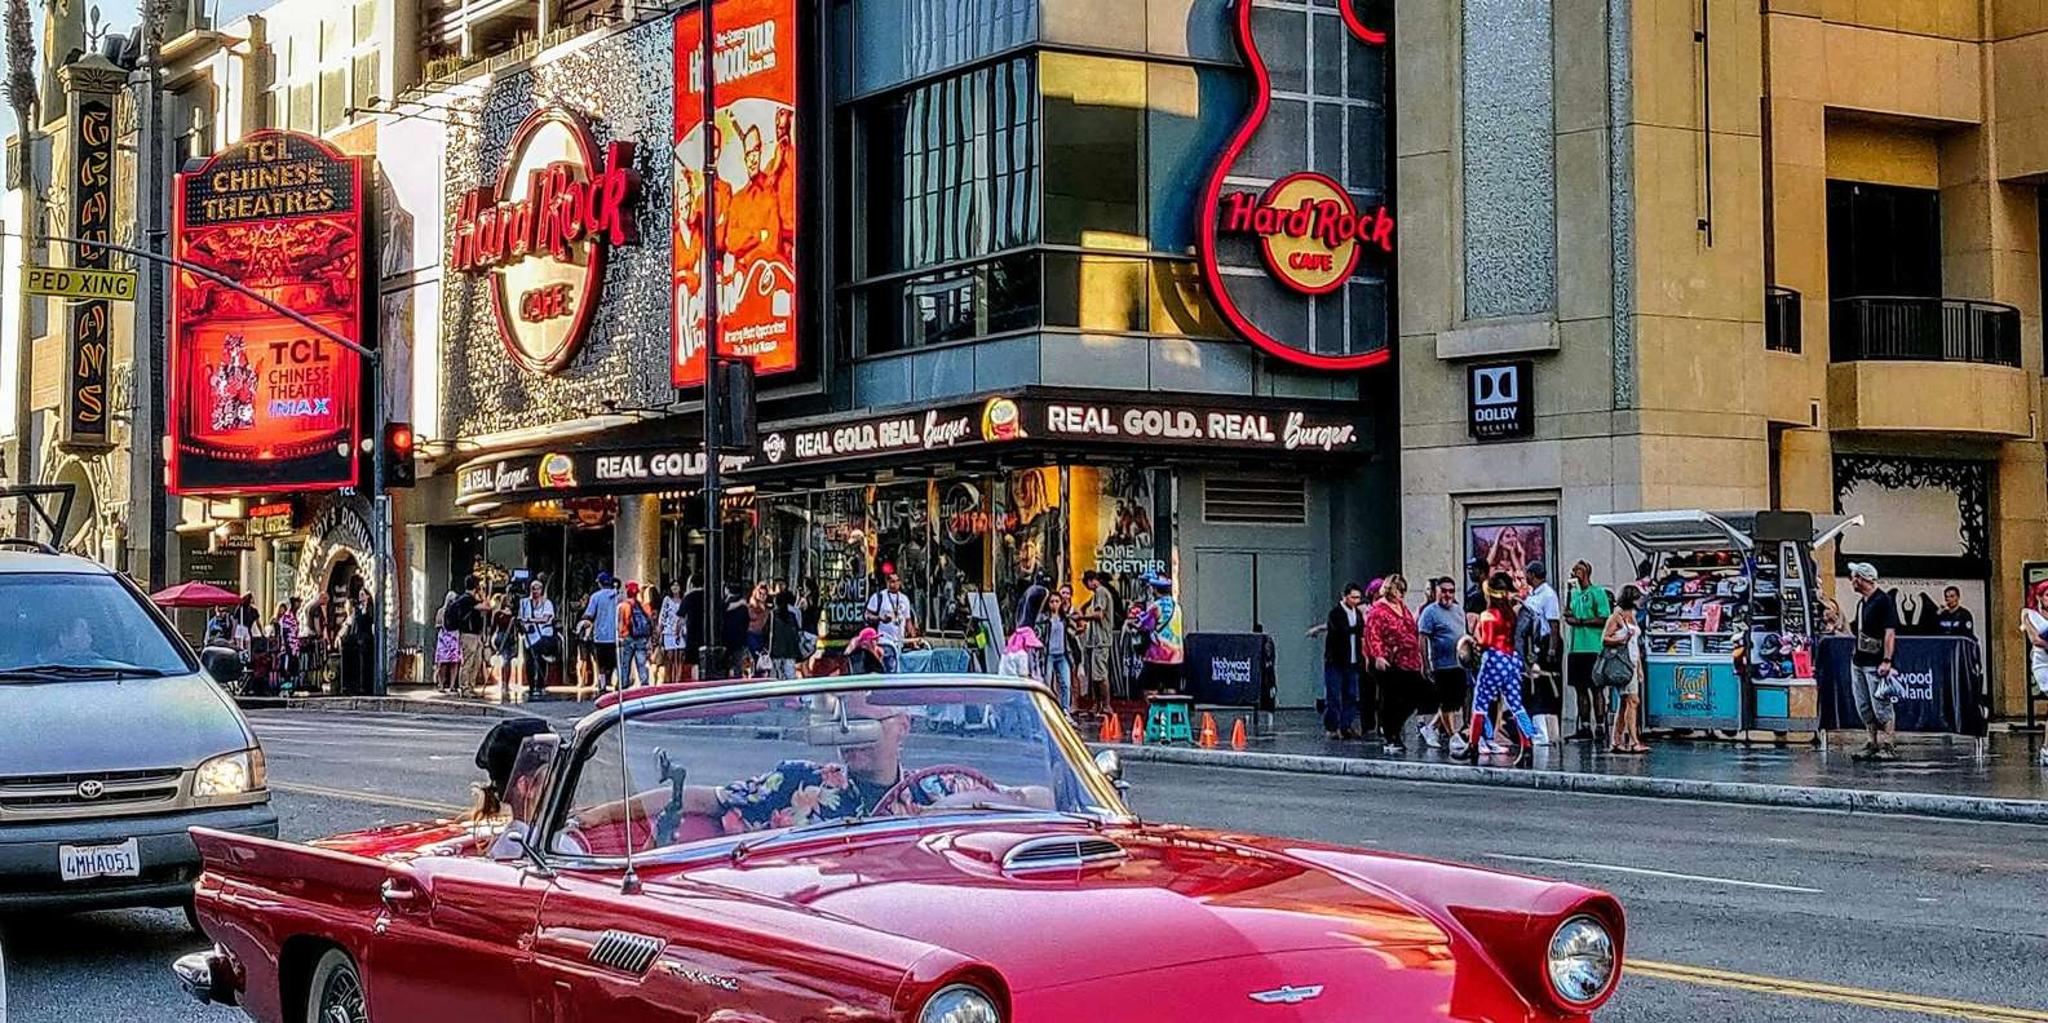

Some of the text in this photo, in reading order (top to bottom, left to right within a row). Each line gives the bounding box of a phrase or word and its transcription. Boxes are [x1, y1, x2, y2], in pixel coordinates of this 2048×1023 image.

[688, 42, 749, 94] HWOOD
[245, 138, 292, 162] TCL
[213, 160, 325, 194] CHINESE
[203, 188, 336, 220] THEATRES
[451, 141, 628, 271] Hard Rock
[1230, 190, 1394, 252] Hard Rock
[81, 110, 110, 422] GRAUANS
[1288, 252, 1333, 271] CAFE
[28, 271, 128, 296] PED XING
[268, 339, 330, 366] TCL
[268, 366, 330, 384] CHINESE
[267, 398, 331, 417] IMAX
[1475, 407, 1518, 422] DOLBY
[795, 409, 970, 458] REAL GOLD. REAL Burger.
[1048, 405, 1358, 452] REAL GOLD. REAL Burger.
[472, 468, 493, 490] REAL
[596, 455, 647, 479] REAL
[338, 486, 356, 496] TCL
[1094, 558, 1166, 573] TOGETHER
[828, 602, 865, 623] TOGE
[66, 852, 134, 876] 4MHA051
